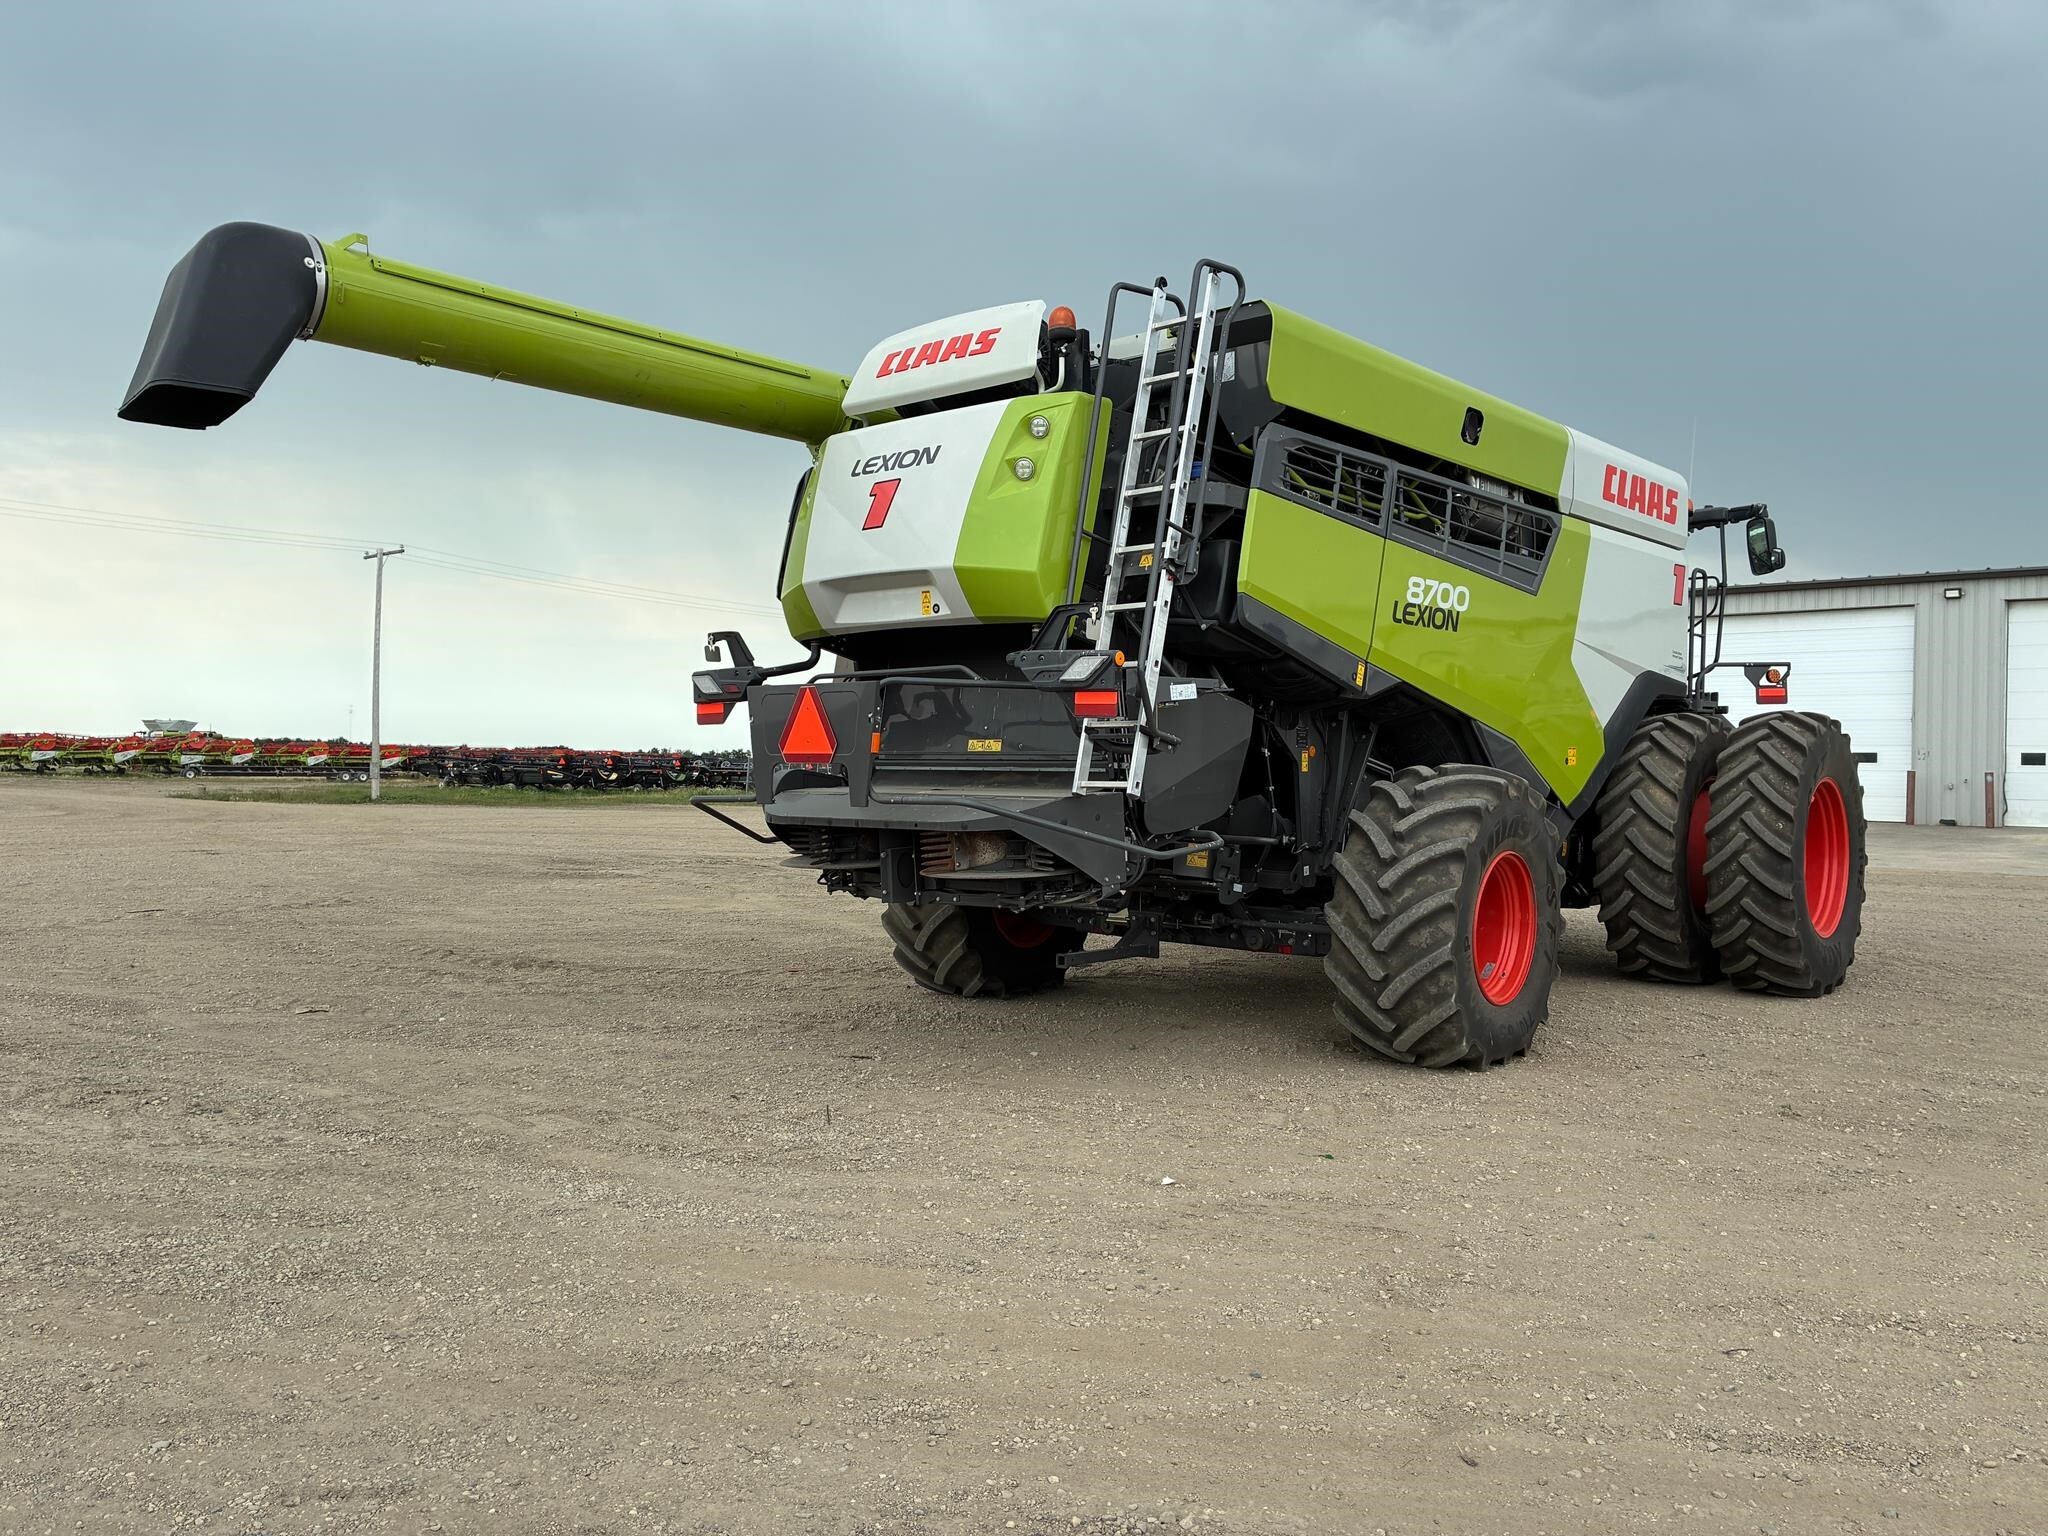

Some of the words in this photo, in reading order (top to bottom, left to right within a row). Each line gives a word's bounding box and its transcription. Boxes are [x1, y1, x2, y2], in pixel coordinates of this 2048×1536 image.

[876, 327, 1002, 379] CLAAS
[851, 444, 942, 477] LEXION
[861, 478, 902, 531] 1
[1602, 463, 1679, 525] CLAAS
[1406, 576, 1470, 612] 8700
[1673, 563, 1686, 606] 1
[1392, 600, 1460, 632] LEXION
